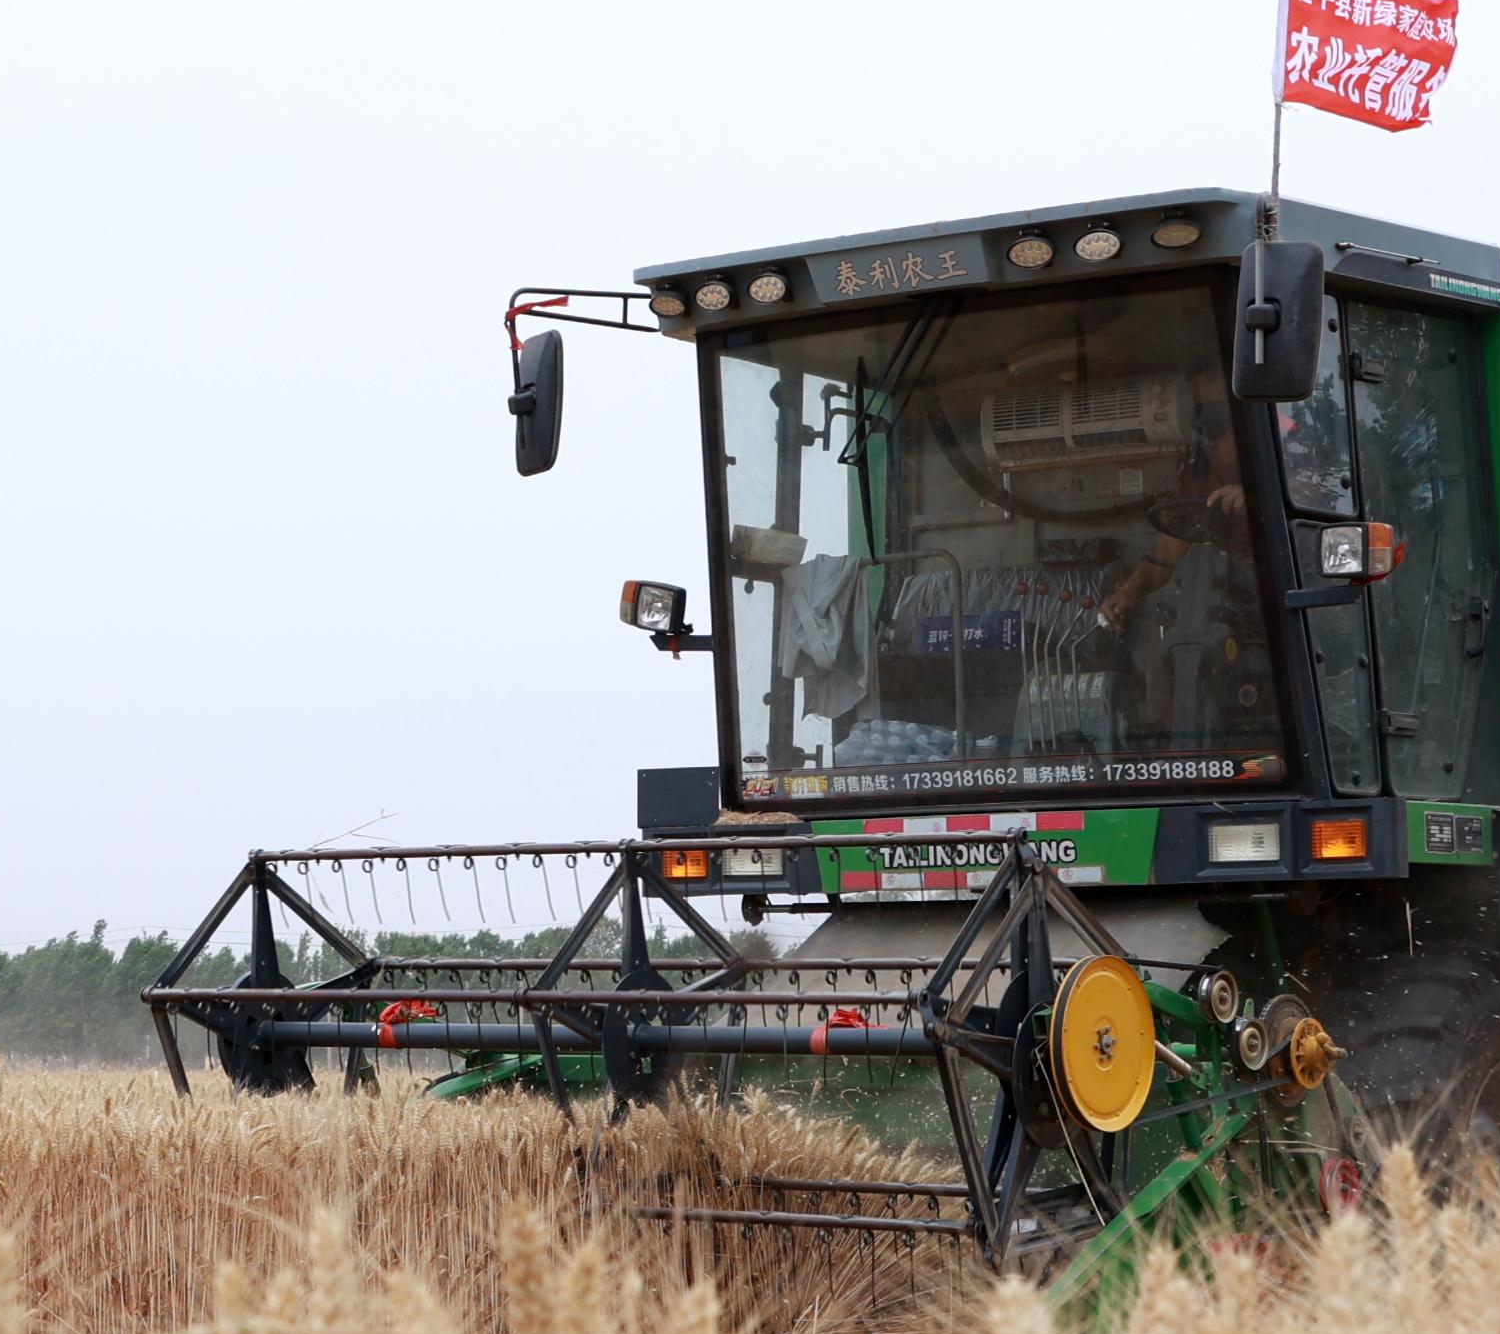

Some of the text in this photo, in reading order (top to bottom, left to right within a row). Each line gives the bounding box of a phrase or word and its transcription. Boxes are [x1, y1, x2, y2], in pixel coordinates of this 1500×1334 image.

[836, 260, 968, 296] 泰利农王
[902, 767, 1018, 790] 17339181662
[1103, 760, 1235, 782] 17339188188
